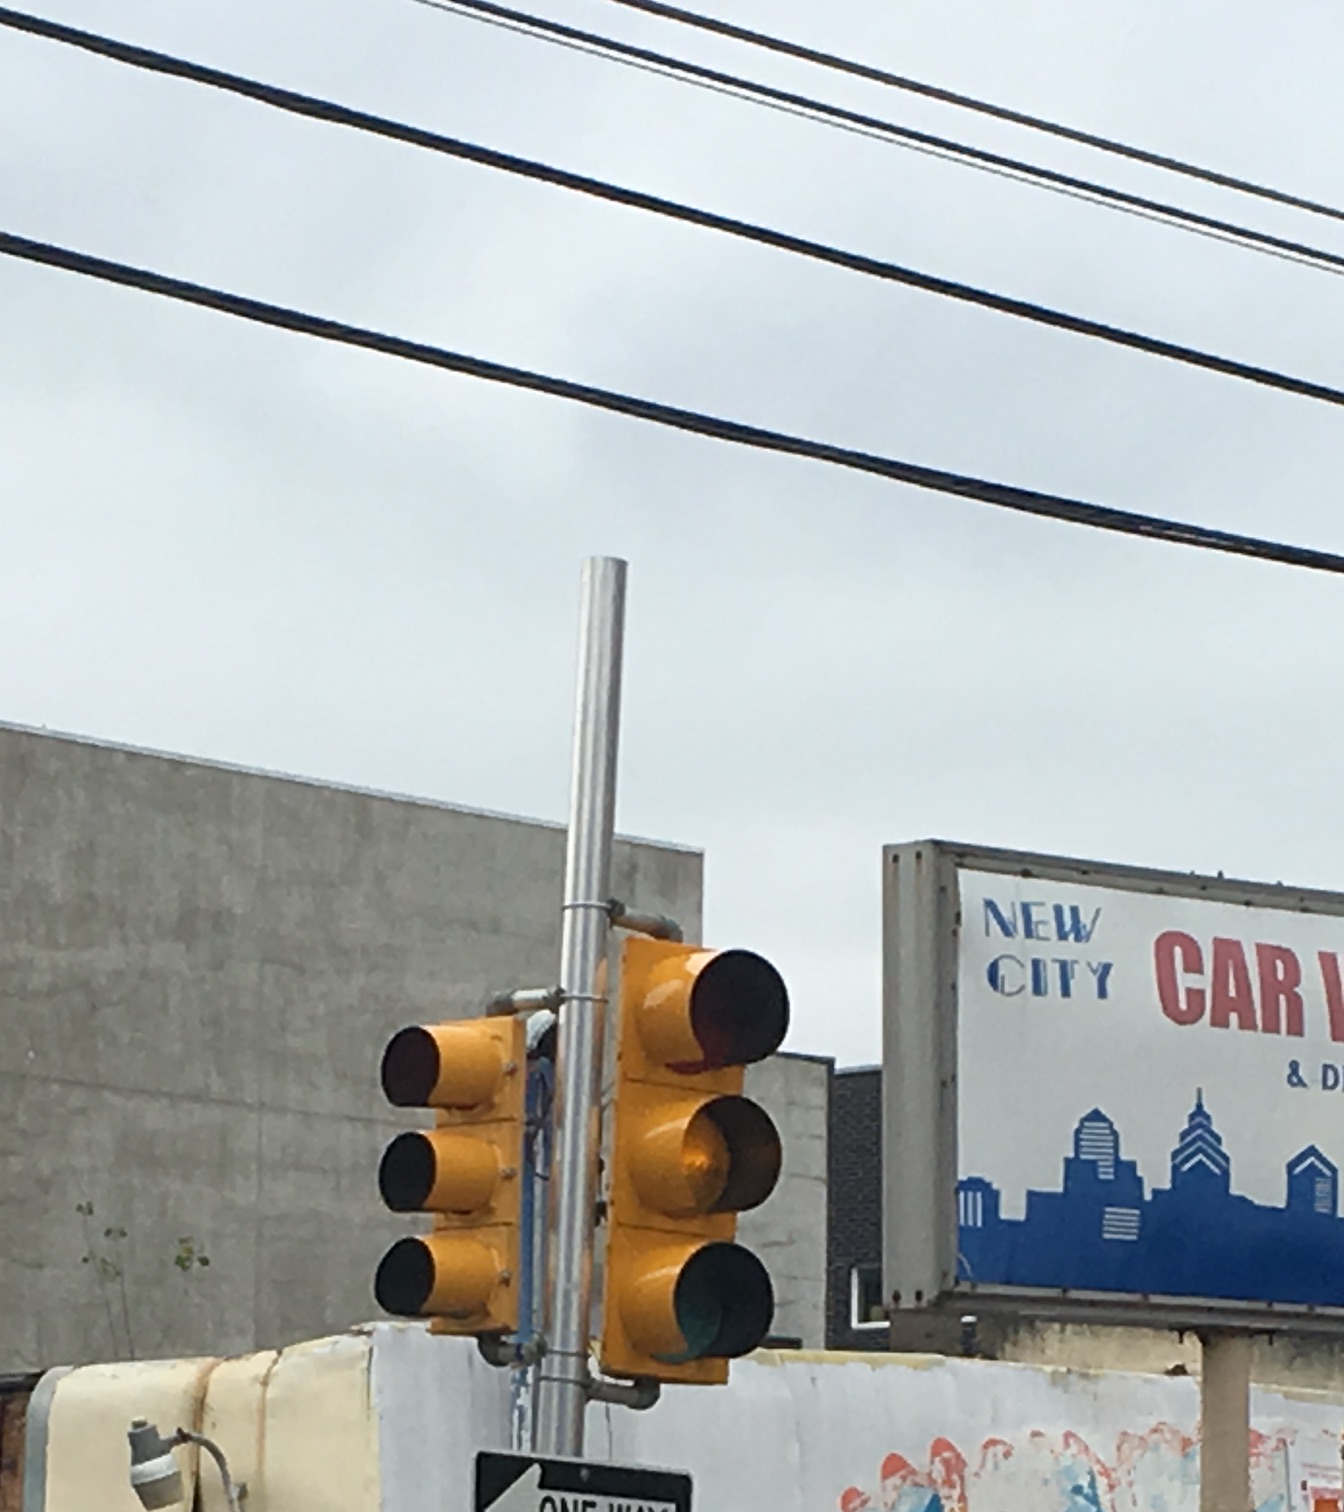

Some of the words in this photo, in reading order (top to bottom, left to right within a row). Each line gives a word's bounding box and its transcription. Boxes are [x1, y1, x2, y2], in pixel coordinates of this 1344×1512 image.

[983, 897, 1102, 943] NEW
[987, 954, 1114, 999] CITY
[1153, 930, 1305, 1037] CAR
[1287, 1059, 1308, 1088] &
